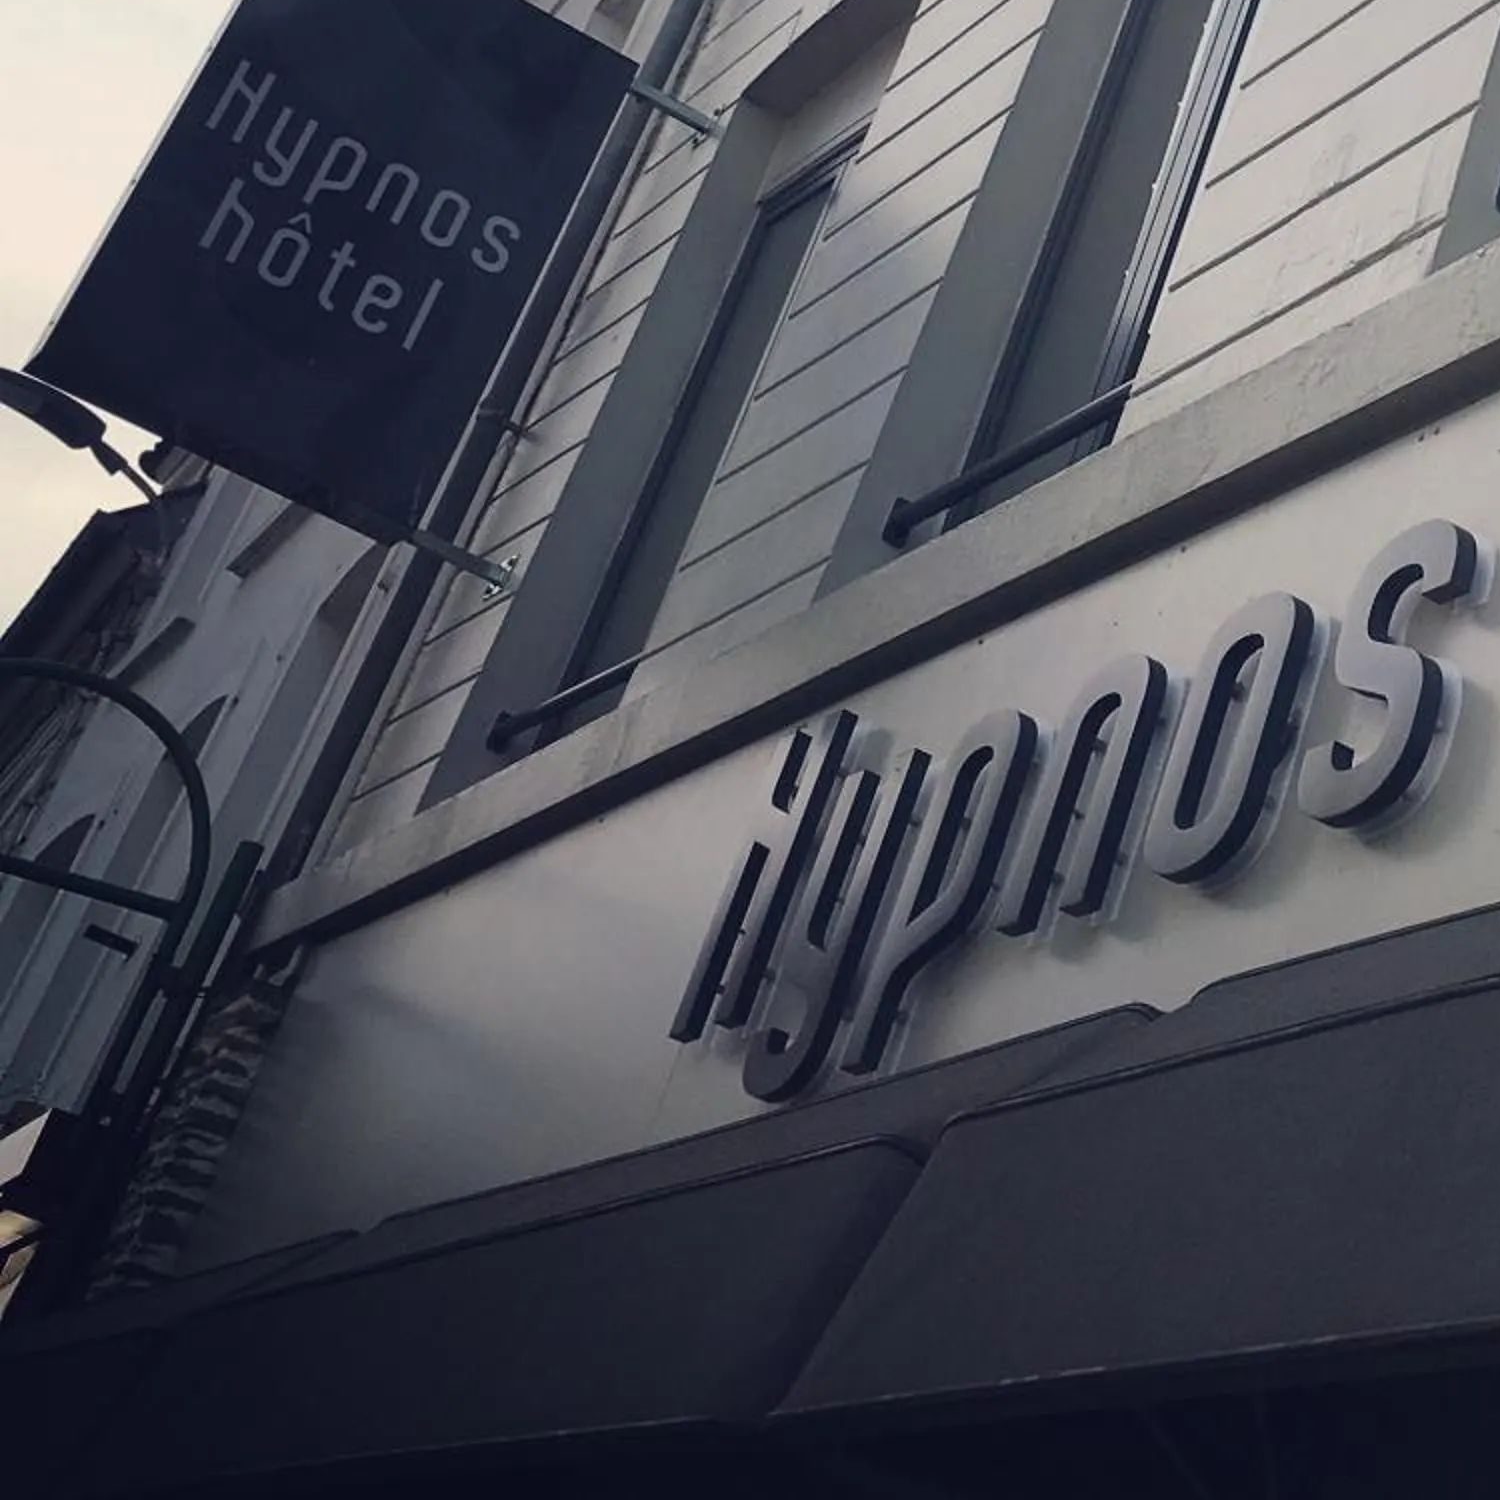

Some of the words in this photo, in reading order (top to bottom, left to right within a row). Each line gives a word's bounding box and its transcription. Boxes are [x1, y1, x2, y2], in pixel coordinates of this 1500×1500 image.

[200, 179, 444, 351] hôtel
[206, 60, 520, 274] Hypnos
[669, 517, 1478, 1102] Hypnos
